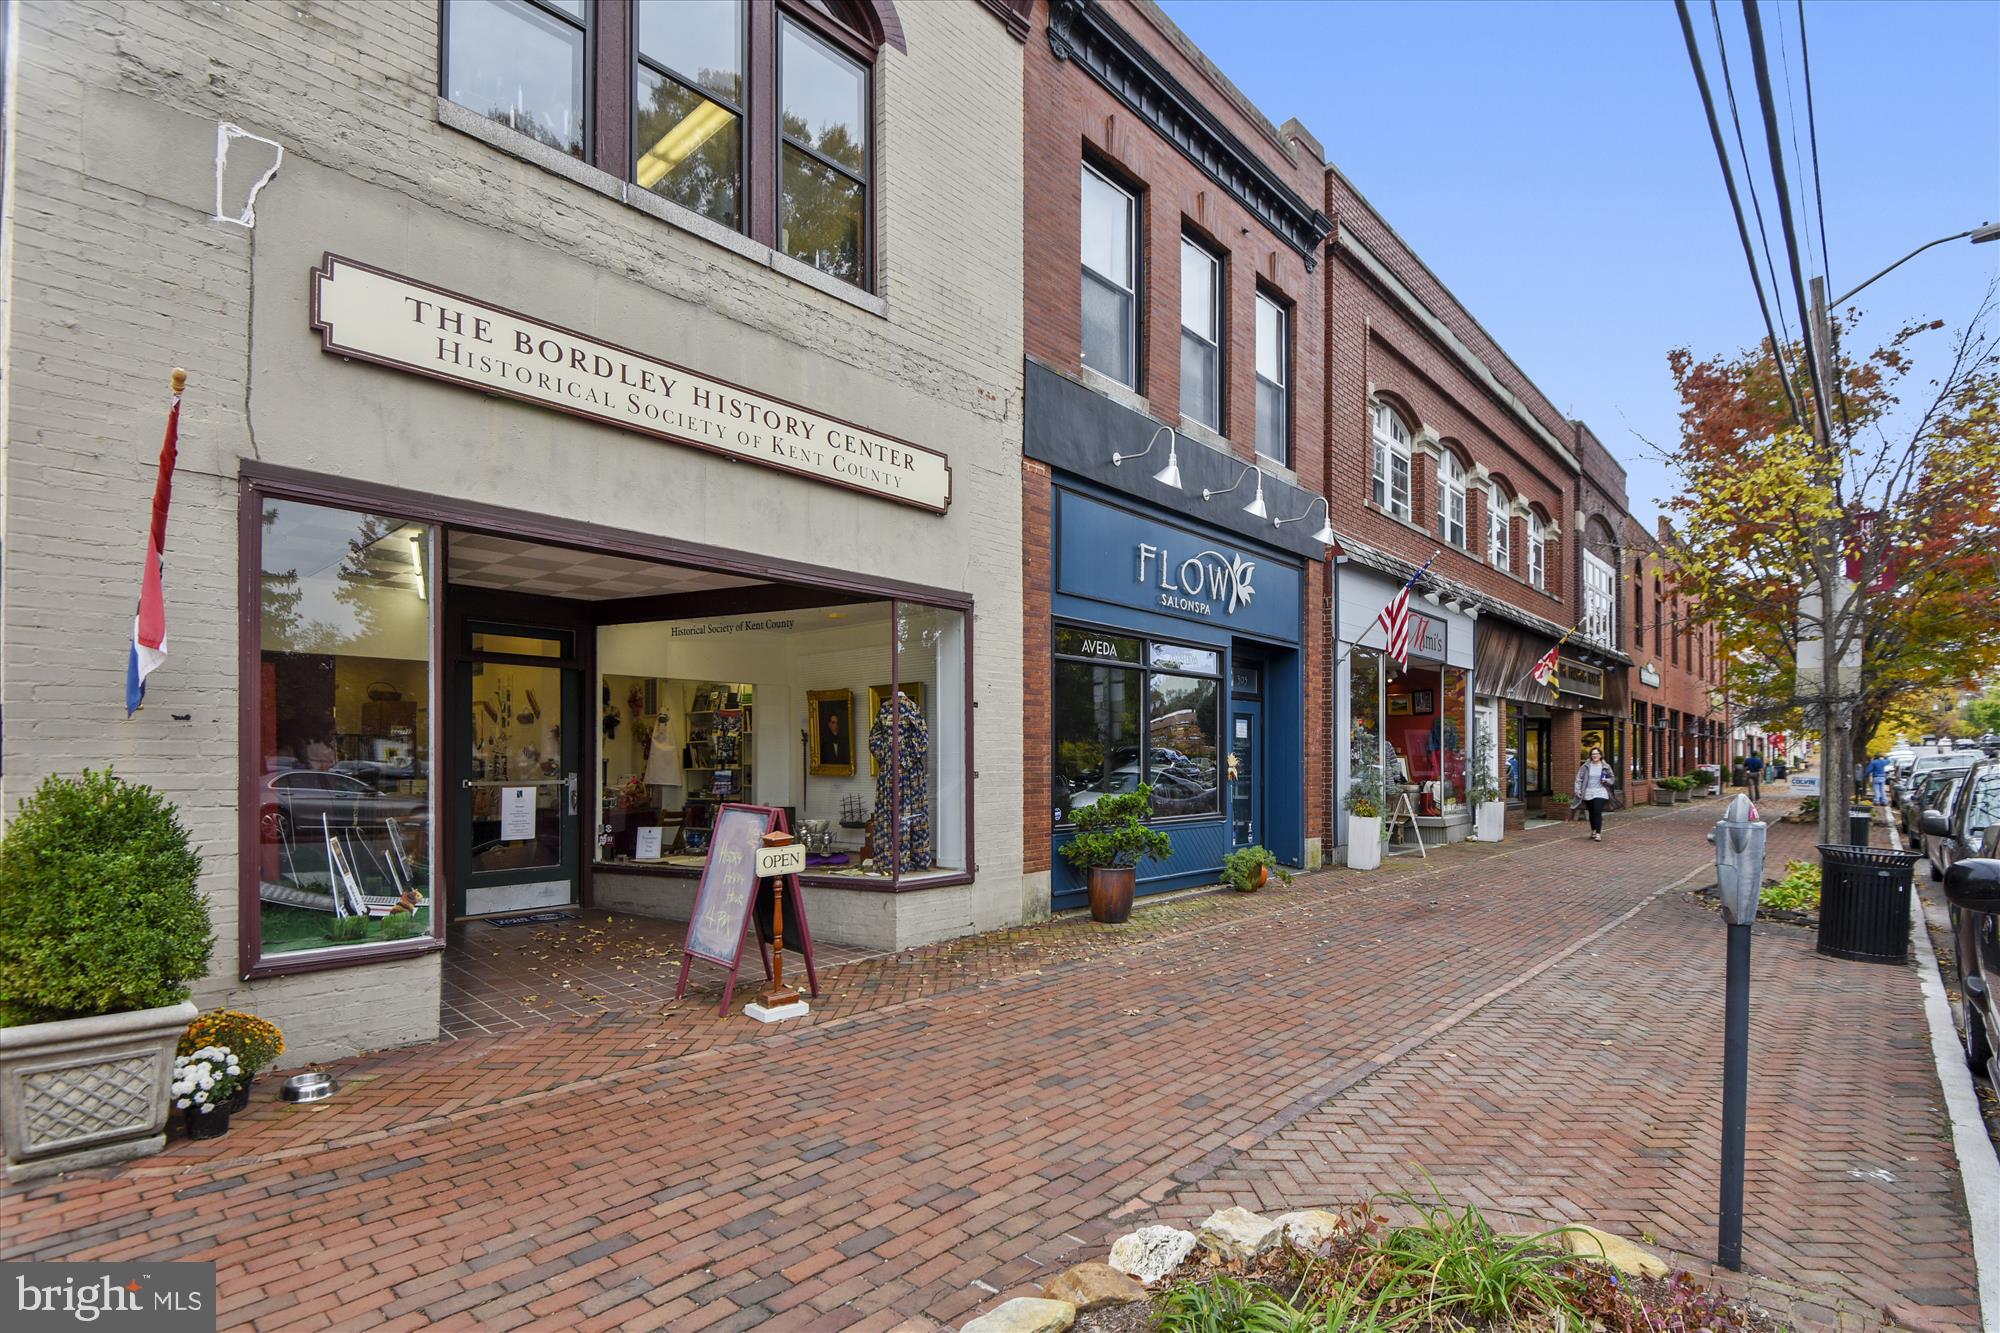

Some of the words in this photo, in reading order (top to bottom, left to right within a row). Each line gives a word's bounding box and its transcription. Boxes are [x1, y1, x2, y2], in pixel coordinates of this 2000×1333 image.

[405, 296, 493, 343] THE
[513, 329, 677, 398] BORDLEY
[692, 386, 816, 440] HISTORY
[827, 430, 916, 471] CENTER
[436, 337, 616, 408] HISTORICAL
[627, 393, 727, 439] SOCIETY
[737, 431, 762, 448] OF
[772, 435, 825, 466] KENT
[833, 454, 902, 488] COUNTY
[1138, 543, 1230, 601] FLOW
[1161, 593, 1211, 615] SALONSPA
[671, 625, 706, 637] Historical
[707, 623, 734, 635] Society
[735, 621, 745, 632] of
[745, 620, 764, 631] Kent
[765, 619, 795, 630] County
[1081, 639, 1118, 657] AVEDA
[762, 852, 801, 869] OPEN
